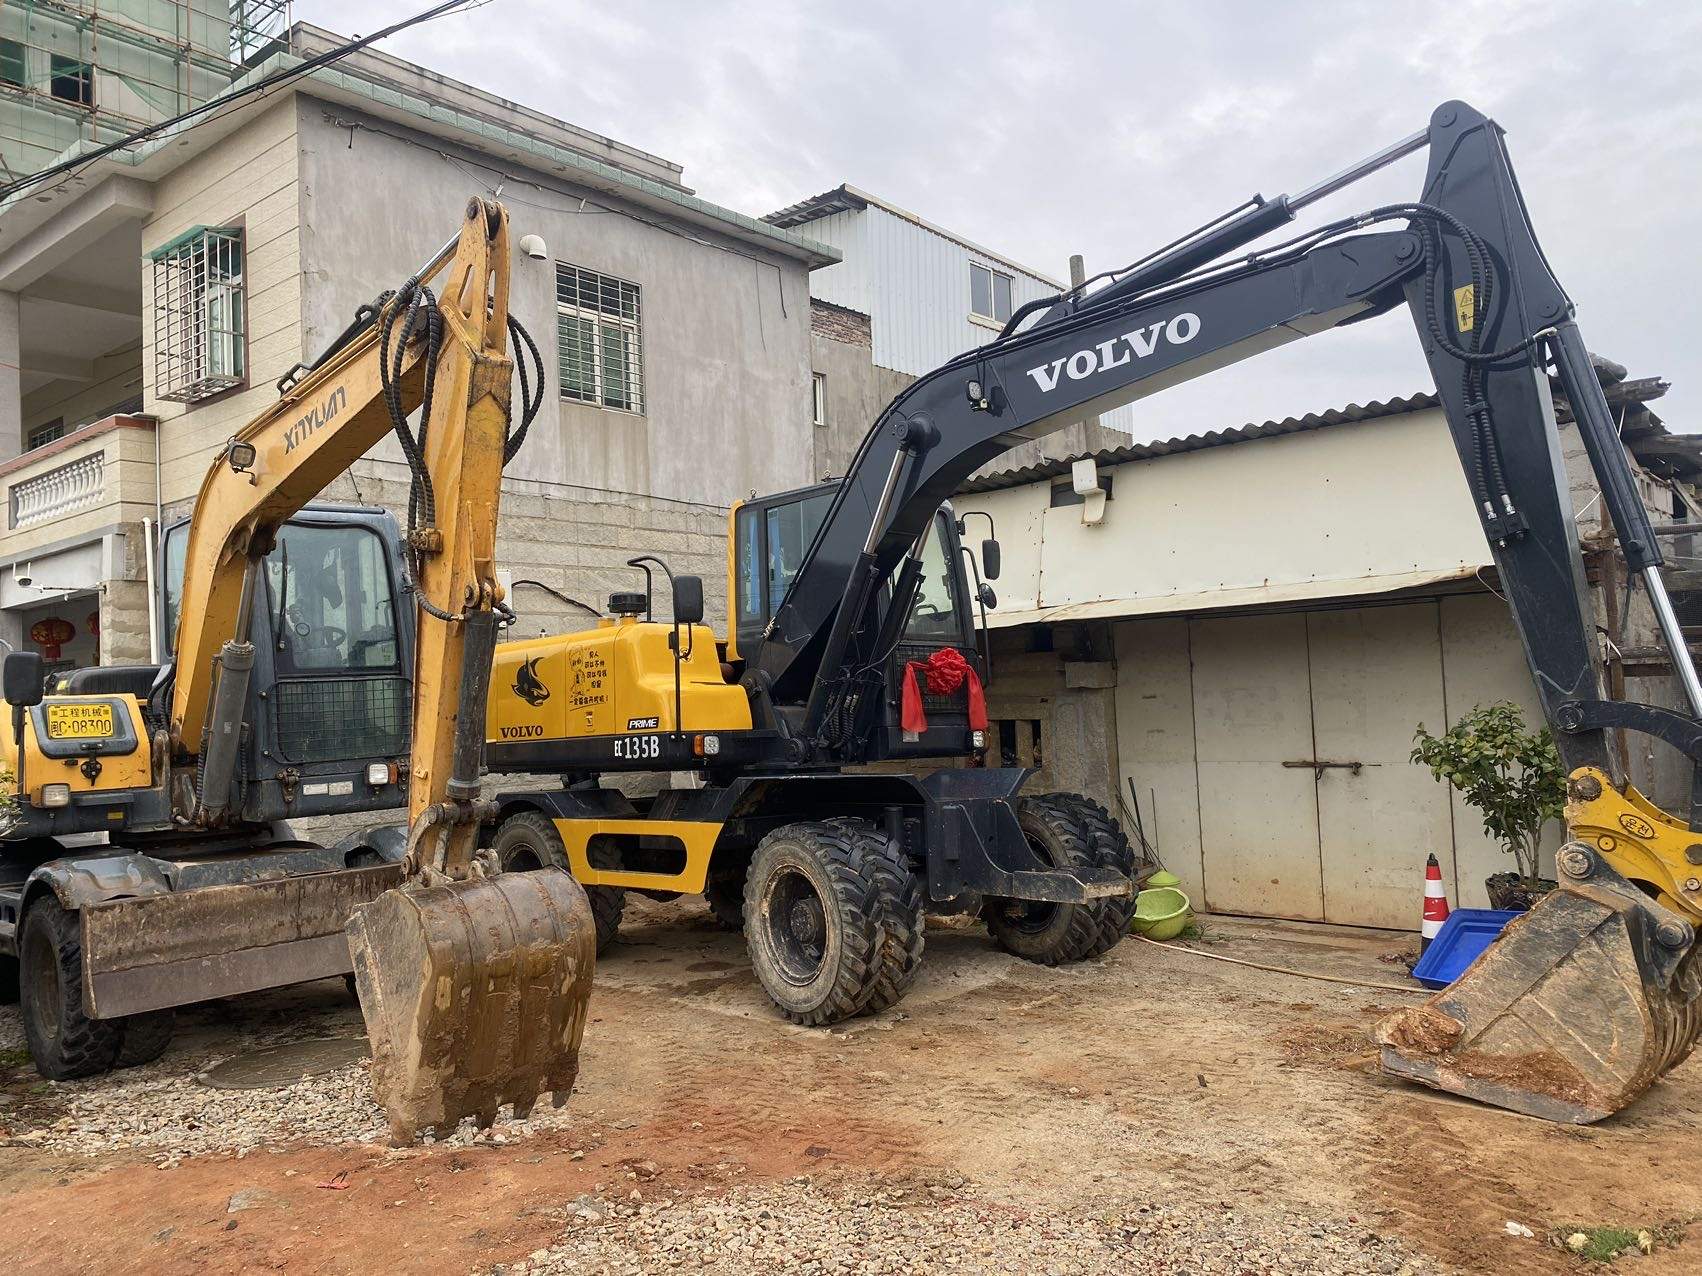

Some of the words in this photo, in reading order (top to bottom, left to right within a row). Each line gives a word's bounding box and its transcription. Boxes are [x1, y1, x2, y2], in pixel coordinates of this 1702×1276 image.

[1026, 312, 1201, 393] VOLVO
[58, 708, 102, 718] 工程机械
[628, 718, 658, 729] PRIME
[500, 725, 544, 739] VOLVO
